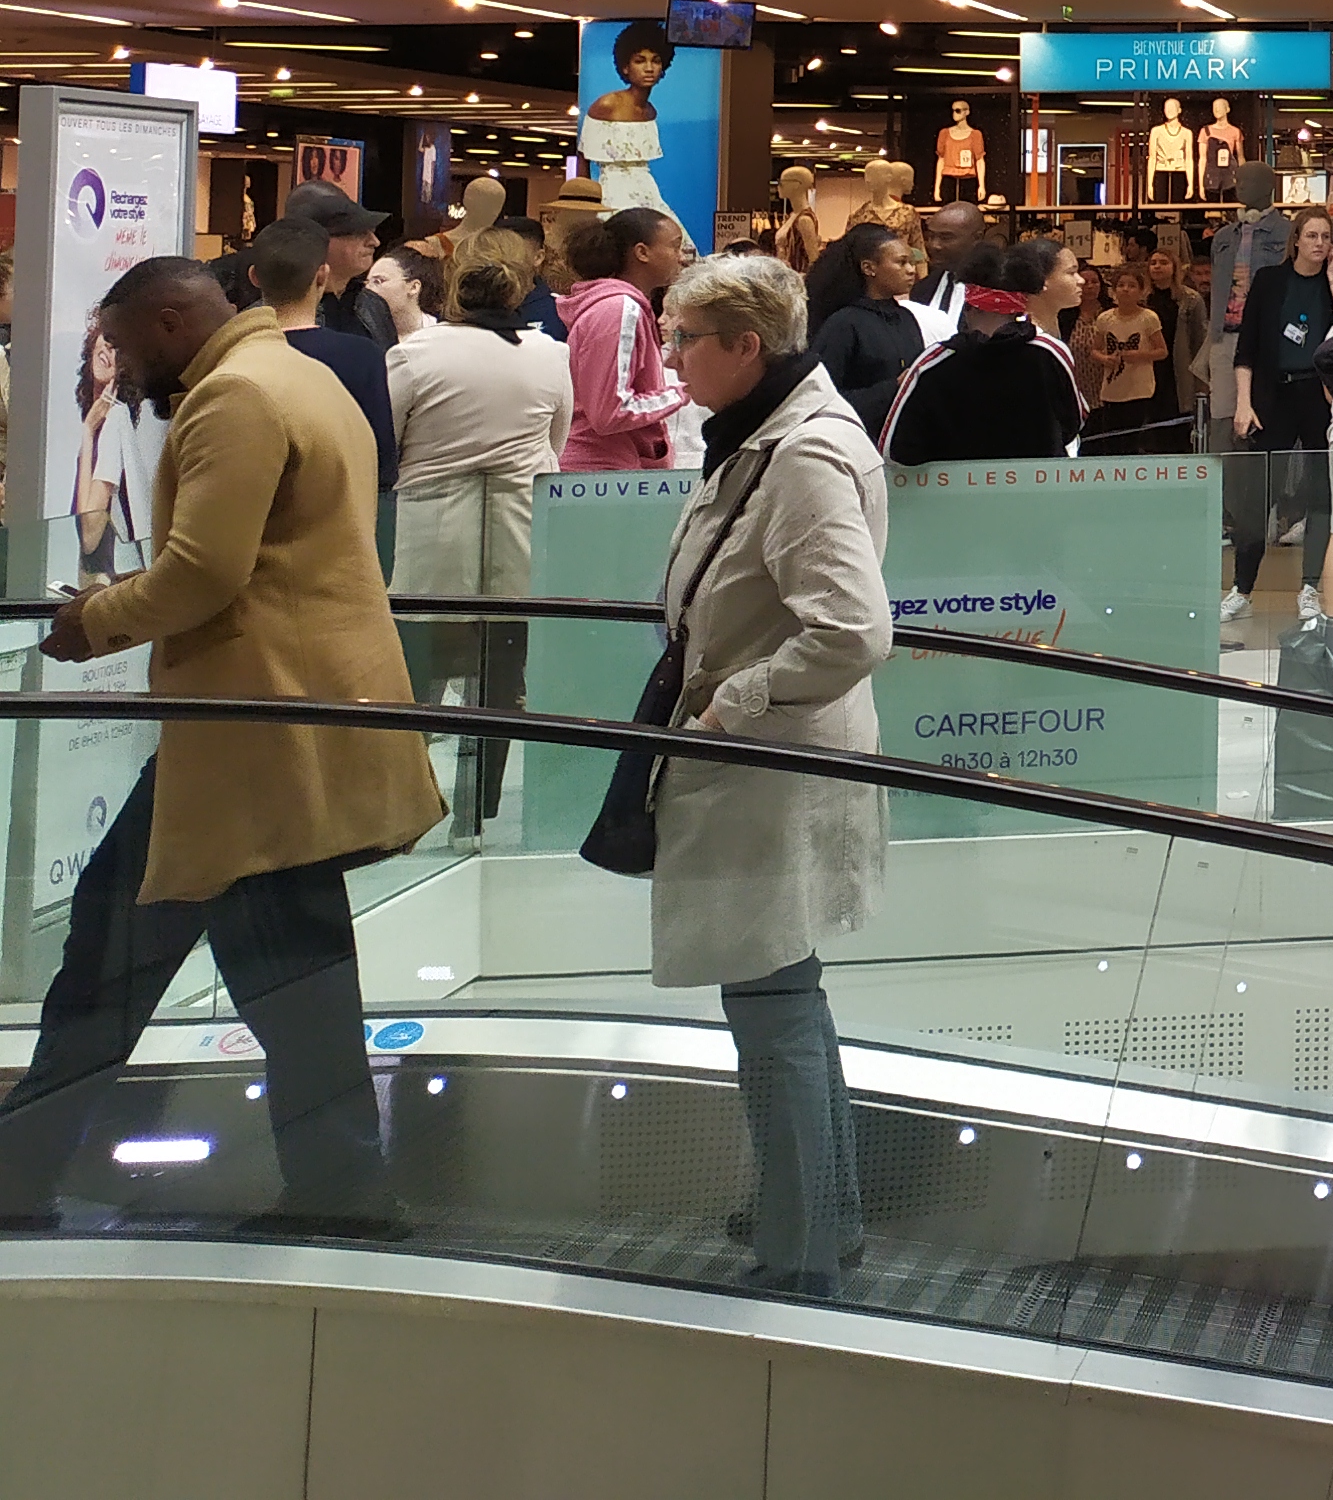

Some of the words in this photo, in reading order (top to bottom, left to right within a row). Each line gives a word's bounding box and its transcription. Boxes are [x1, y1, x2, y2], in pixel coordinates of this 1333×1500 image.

[1133, 40, 1186, 56] BIENVENUE
[1189, 39, 1215, 56] CHEZ
[1095, 57, 1250, 80] PRIMARK
[60, 116, 93, 129] OUVERT
[96, 120, 117, 132] TOUS
[118, 122, 133, 134] LES
[135, 123, 177, 138] DIMANCHES
[110, 190, 148, 209] Rechargez
[110, 208, 128, 220] votre
[128, 207, 146, 222] style
[893, 472, 950, 488] OUS
[966, 469, 1018, 486] LES
[1035, 464, 1209, 484] DIMANCHES
[549, 480, 692, 499] NOUVEAU
[890, 597, 928, 622] gez
[932, 593, 995, 614] votre
[999, 588, 1057, 616] style
[82, 660, 128, 684] BOUTIQUES
[914, 707, 1106, 739] CARREFOUR
[940, 751, 994, 771] 8h30
[1000, 752, 1011, 769] à
[1017, 747, 1079, 768] 12h30
